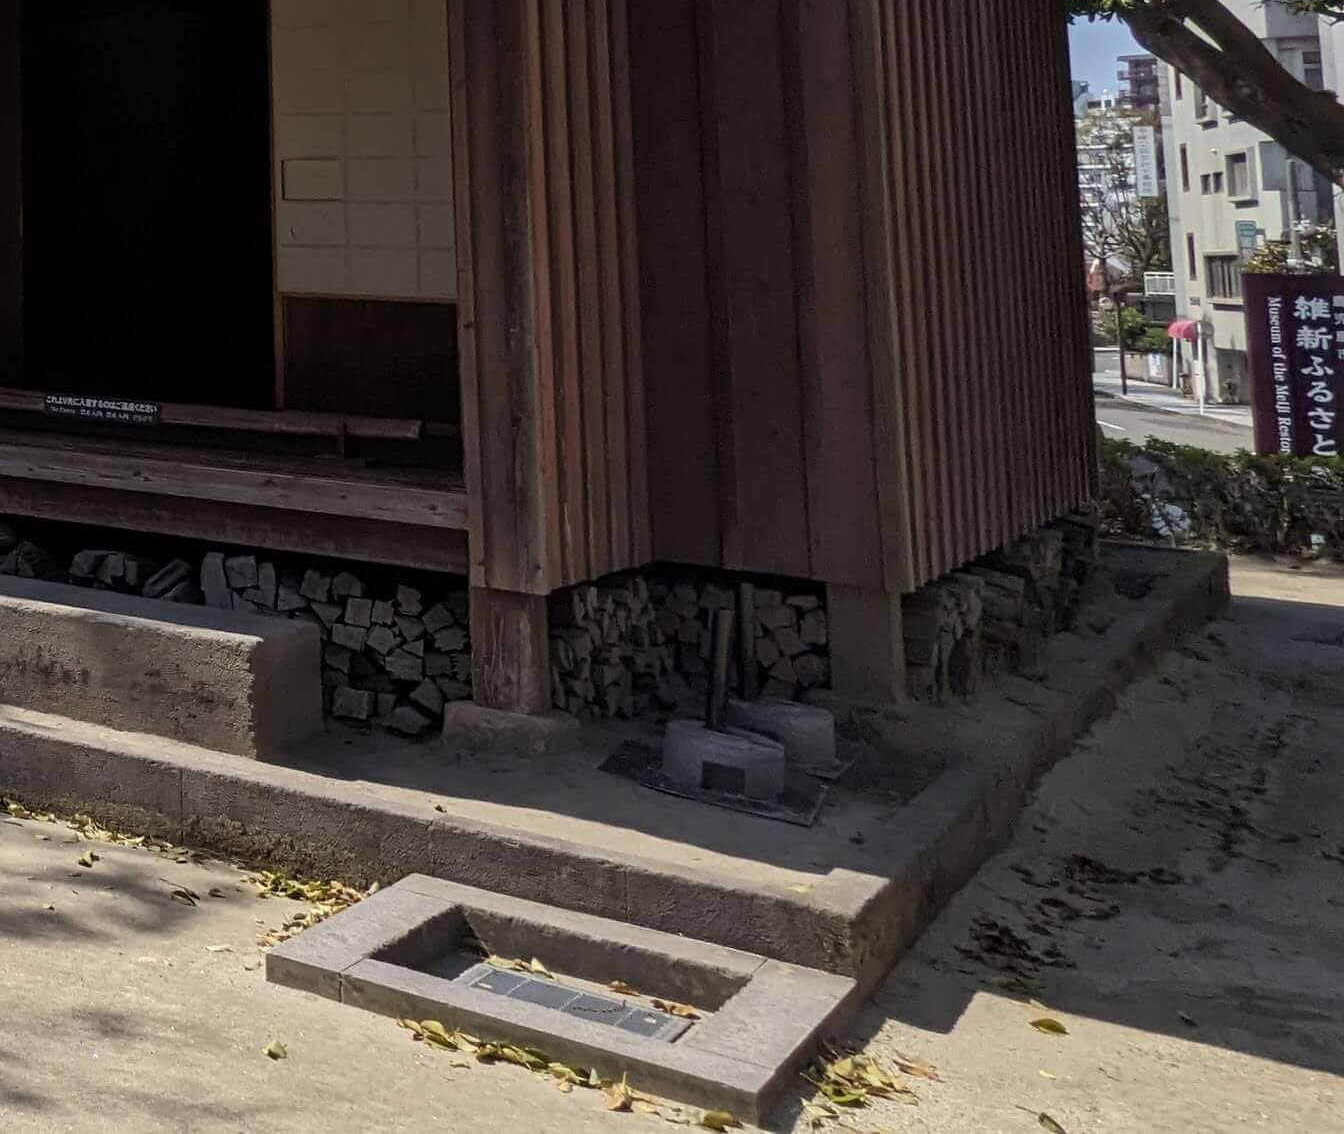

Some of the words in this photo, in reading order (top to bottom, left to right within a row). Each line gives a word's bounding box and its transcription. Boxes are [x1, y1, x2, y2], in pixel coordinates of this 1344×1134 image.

[1268, 297, 1283, 343] Museum
[1272, 346, 1286, 359] of
[1274, 360, 1288, 382] the
[1275, 384, 1291, 413] Meiji
[1293, 294, 1338, 482] 維新ふるさと
